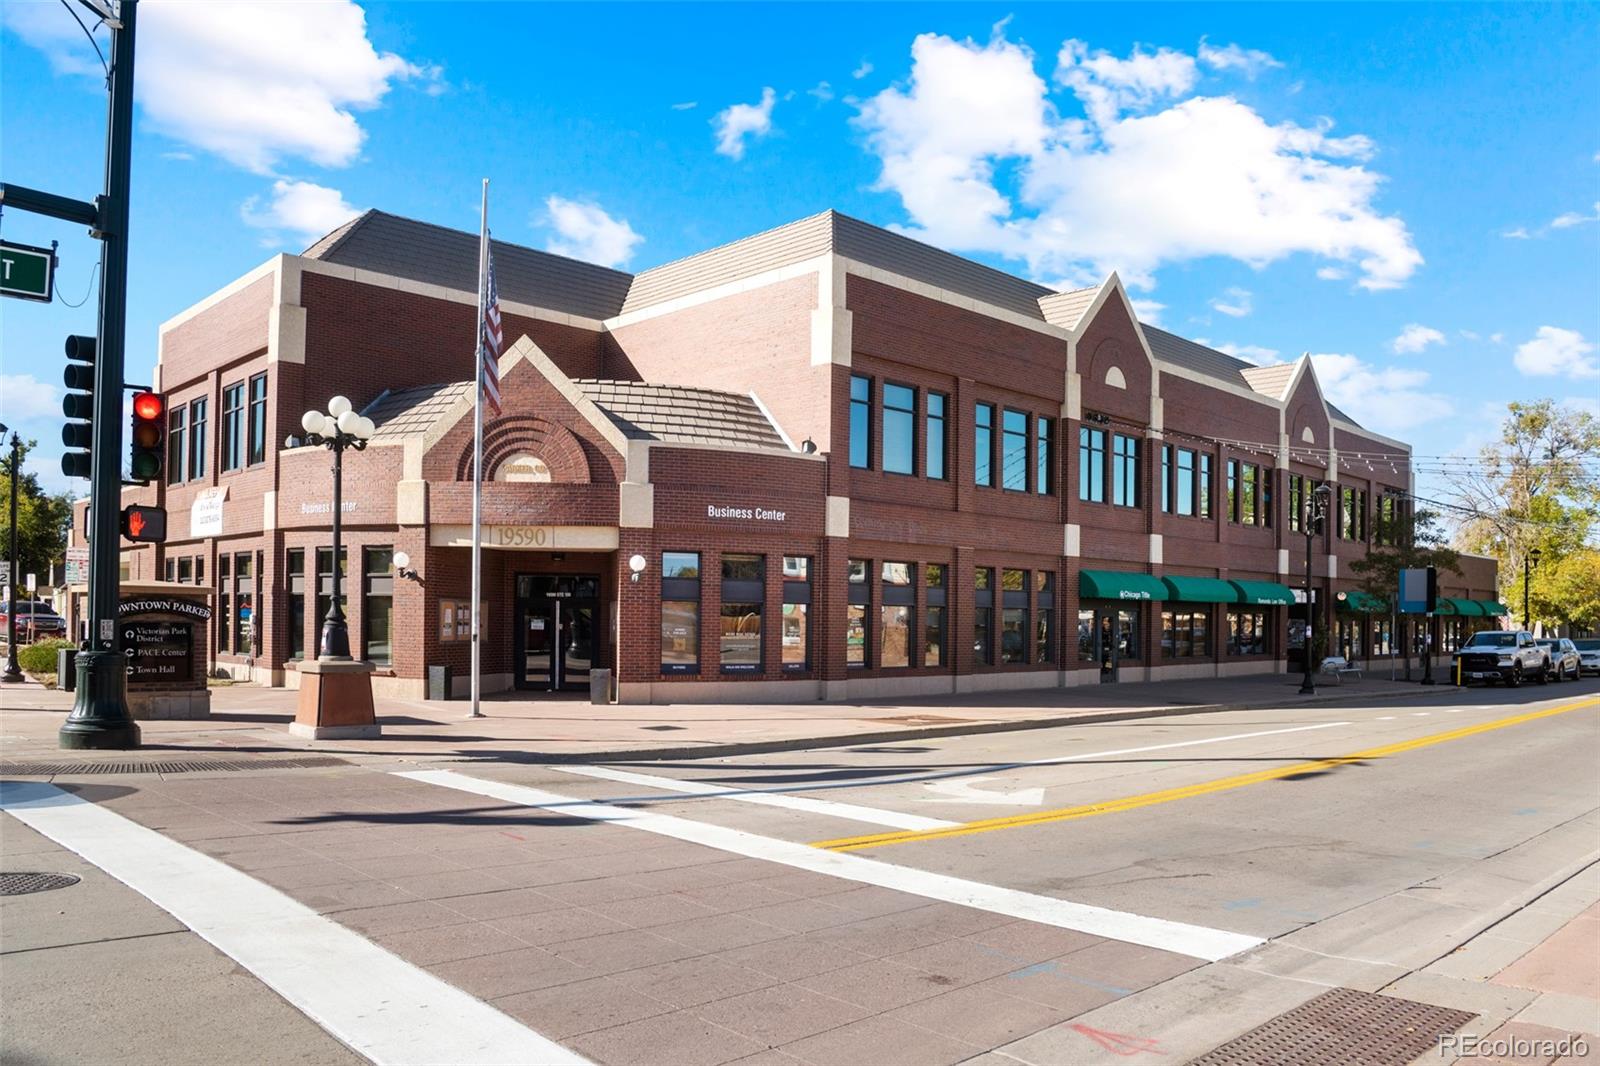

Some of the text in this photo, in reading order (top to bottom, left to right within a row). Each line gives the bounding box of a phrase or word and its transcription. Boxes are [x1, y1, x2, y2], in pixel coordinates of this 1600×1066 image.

[708, 505, 785, 521] Business Center
[498, 527, 546, 546] 19590
[119, 601, 170, 613] WNTOWN
[136, 627, 187, 635] Victorian Park
